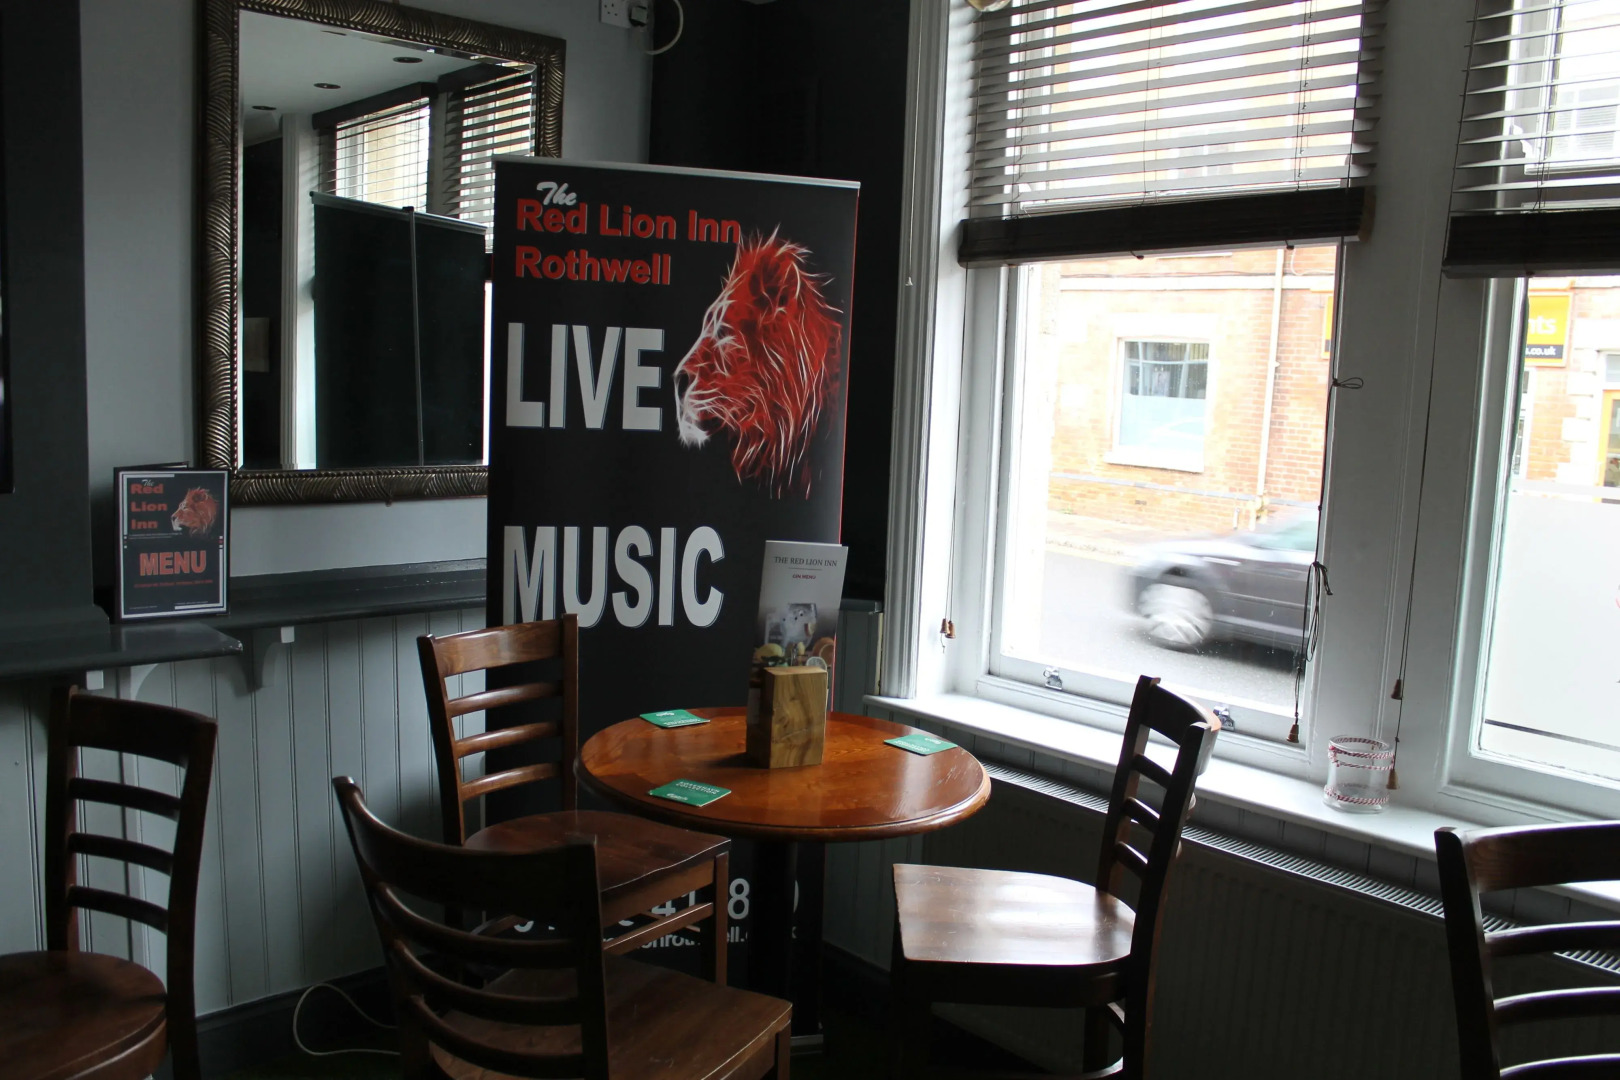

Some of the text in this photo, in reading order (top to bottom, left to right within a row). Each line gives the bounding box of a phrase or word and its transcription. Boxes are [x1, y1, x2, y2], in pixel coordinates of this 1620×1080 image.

[536, 181, 578, 206] The
[516, 198, 741, 244] Red Lion Inn
[515, 246, 671, 285] Rothwell
[505, 322, 665, 431] LIVE
[130, 483, 164, 494] Red
[131, 501, 168, 512] Lion
[131, 519, 158, 530] Inn
[139, 551, 207, 576] MENU
[774, 556, 789, 564] THE
[790, 557, 805, 565] RED
[503, 525, 725, 628] MUSIC
